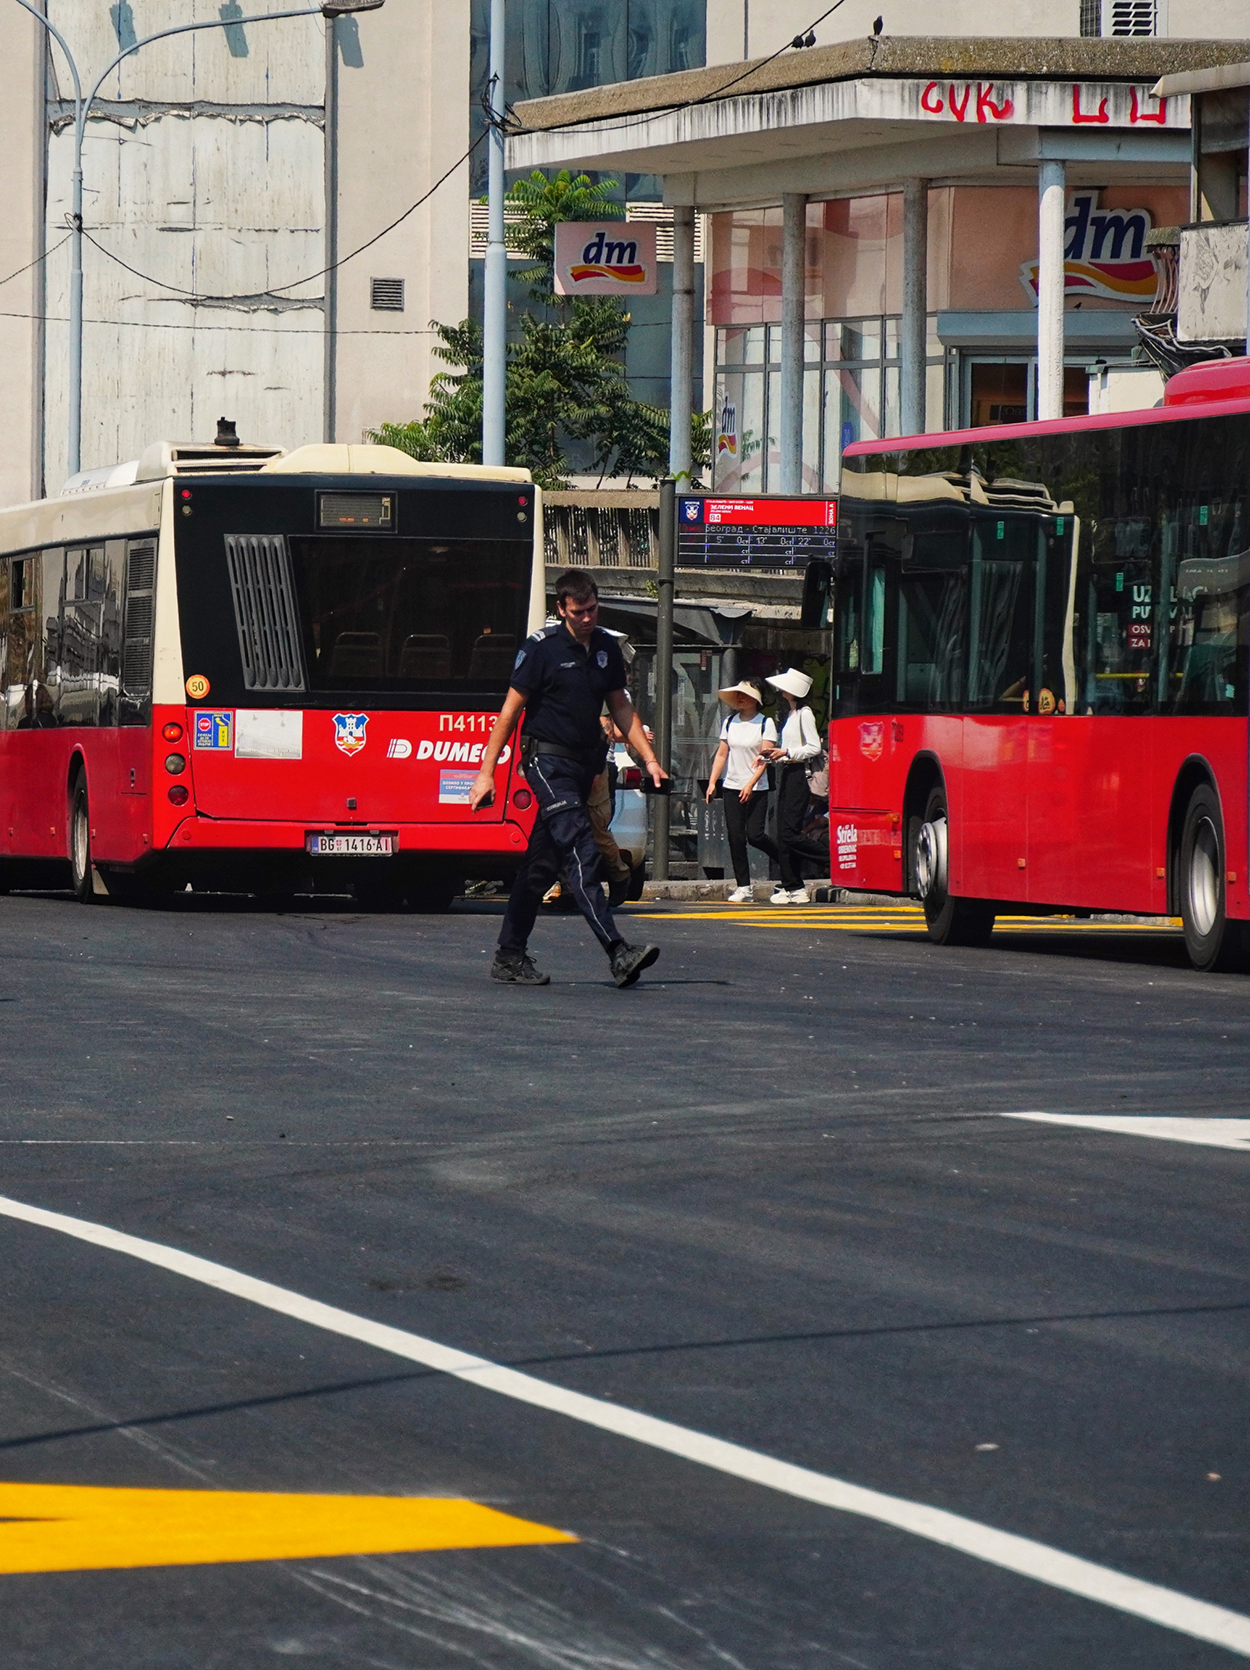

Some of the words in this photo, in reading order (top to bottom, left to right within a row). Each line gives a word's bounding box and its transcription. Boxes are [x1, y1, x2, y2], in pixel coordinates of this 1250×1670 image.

[1064, 197, 1146, 260] dm
[583, 232, 637, 264] dm
[721, 396, 736, 433] dm
[191, 681, 204, 692] 50
[439, 714, 498, 732] П4113
[320, 838, 335, 851] BG
